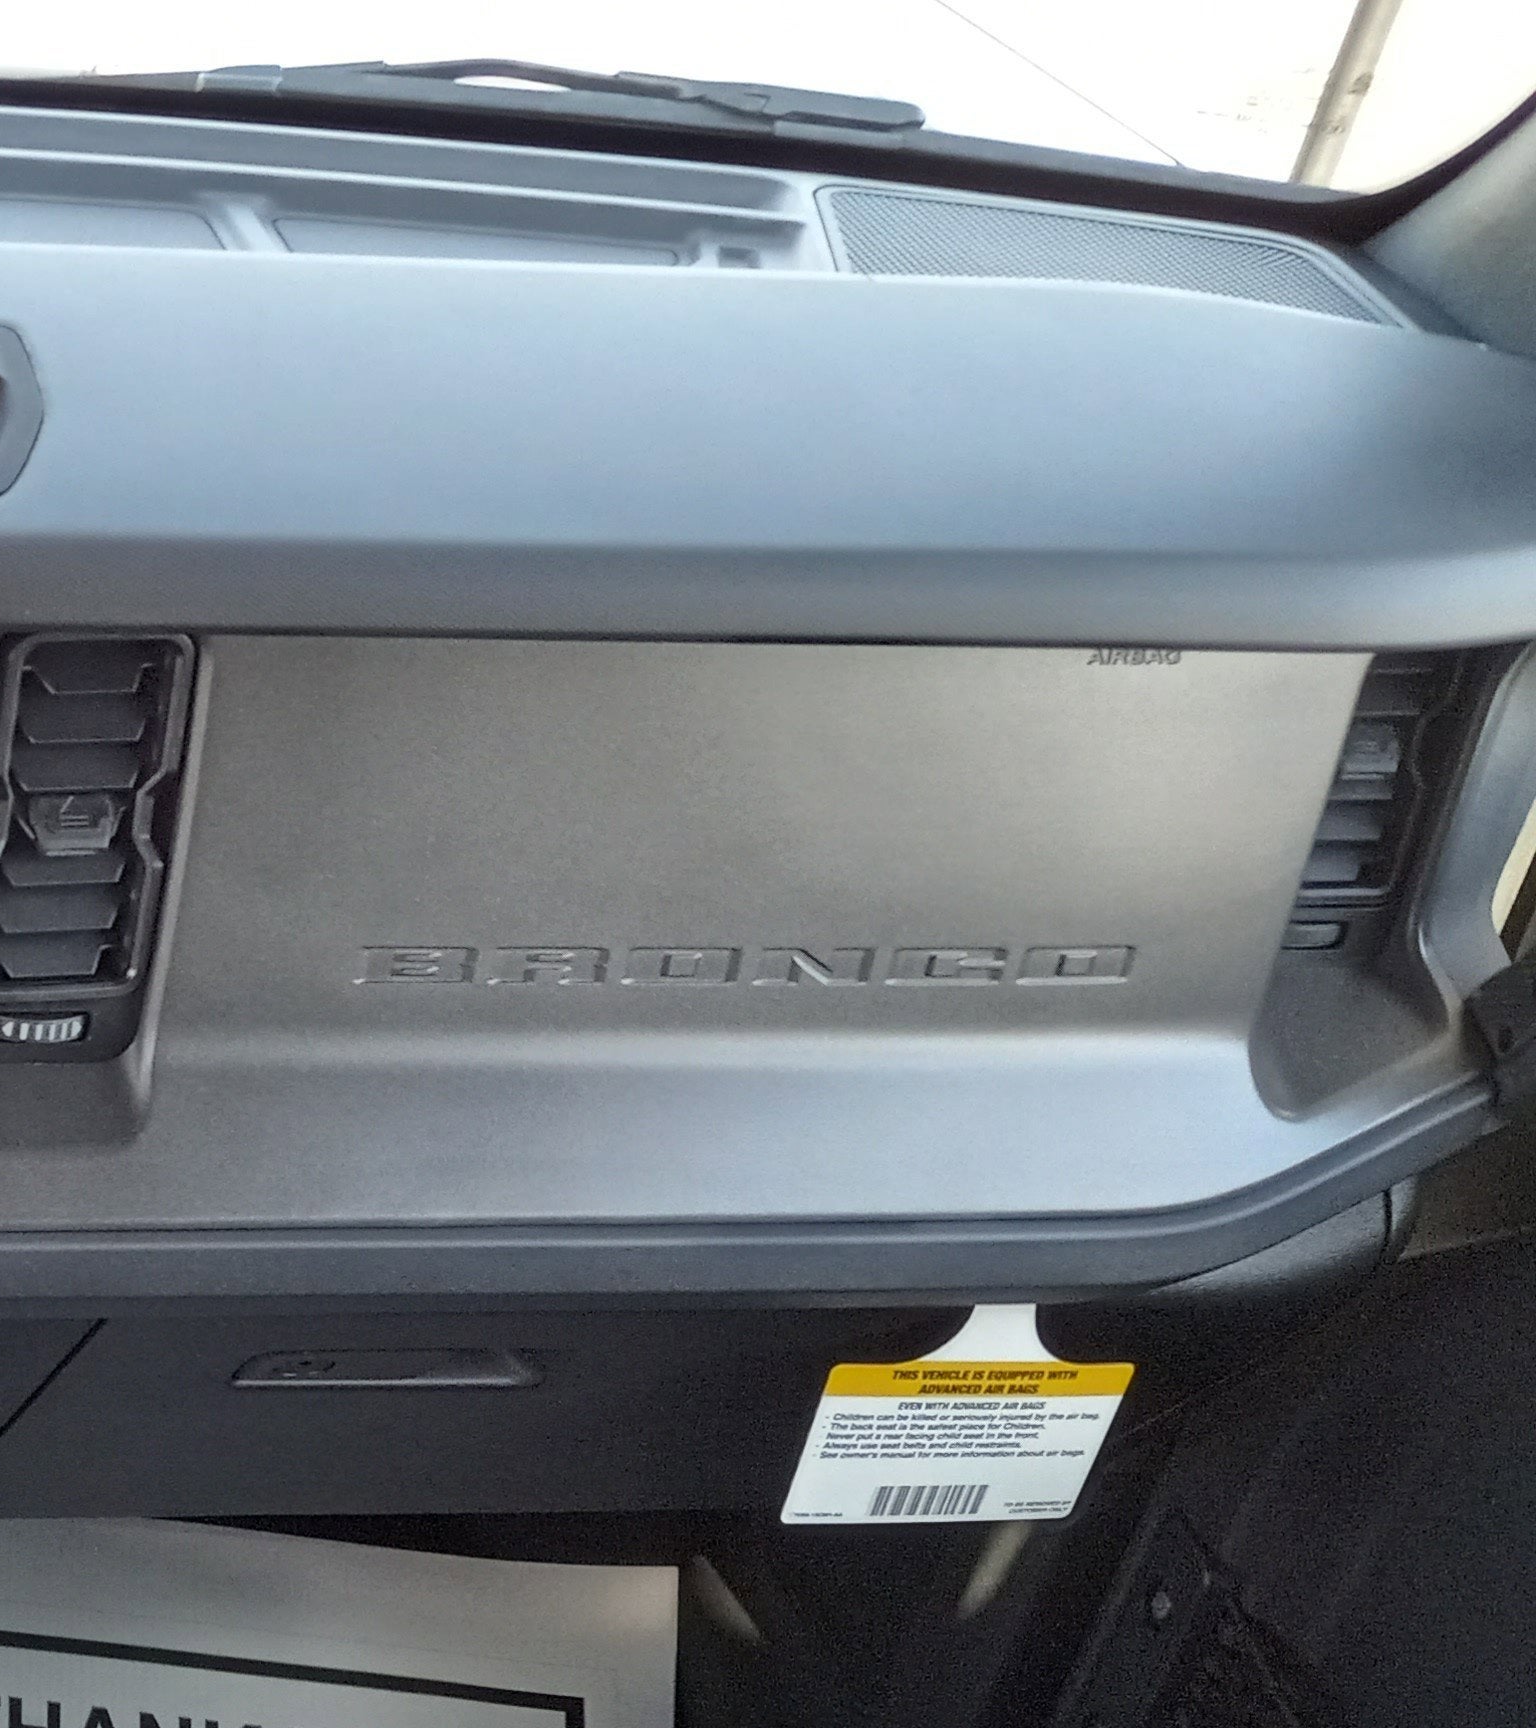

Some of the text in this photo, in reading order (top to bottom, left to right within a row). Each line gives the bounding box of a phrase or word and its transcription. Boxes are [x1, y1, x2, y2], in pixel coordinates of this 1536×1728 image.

[353, 945, 1138, 988] BRONCO
[893, 1370, 1078, 1380] THIS VEHICLE IS EQUIPPED WITH
[918, 1385, 1040, 1394] ADVANCED AIR BAGS
[898, 1402, 1046, 1410] EVEN WITH ADVANCED AIR BAGS
[833, 1413, 874, 1421] Children
[911, 1413, 937, 1421] killed
[952, 1414, 997, 1422] seriously
[999, 1414, 1033, 1422] injured
[1034, 1414, 1046, 1422] by
